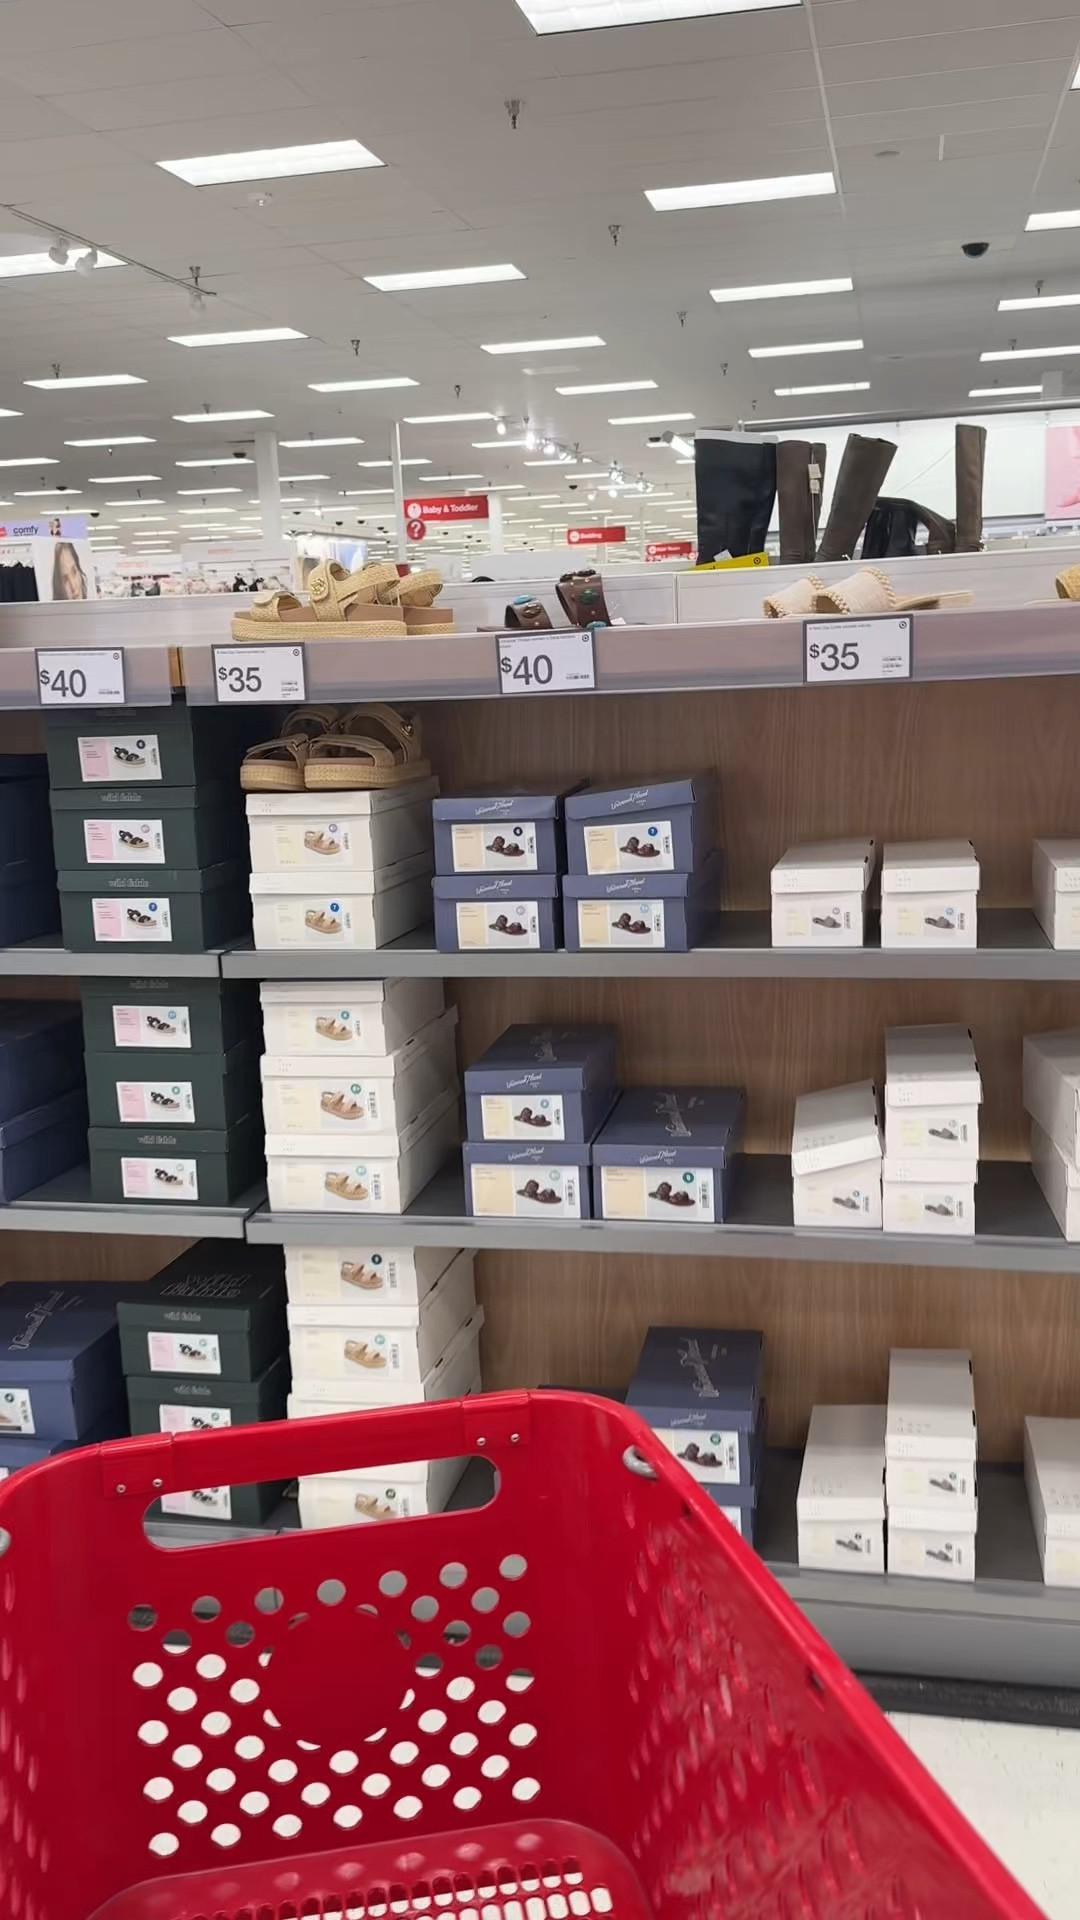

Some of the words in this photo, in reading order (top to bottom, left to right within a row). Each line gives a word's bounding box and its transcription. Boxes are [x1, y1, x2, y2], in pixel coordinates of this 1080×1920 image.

[422, 505, 442, 515] Baby
[443, 504, 450, 513] &
[449, 503, 479, 512] Toddler
[13, 525, 39, 535] comfy
[501, 654, 553, 686] $40
[809, 642, 859, 671] $35
[40, 668, 87, 698] $40
[218, 666, 262, 693] $35
